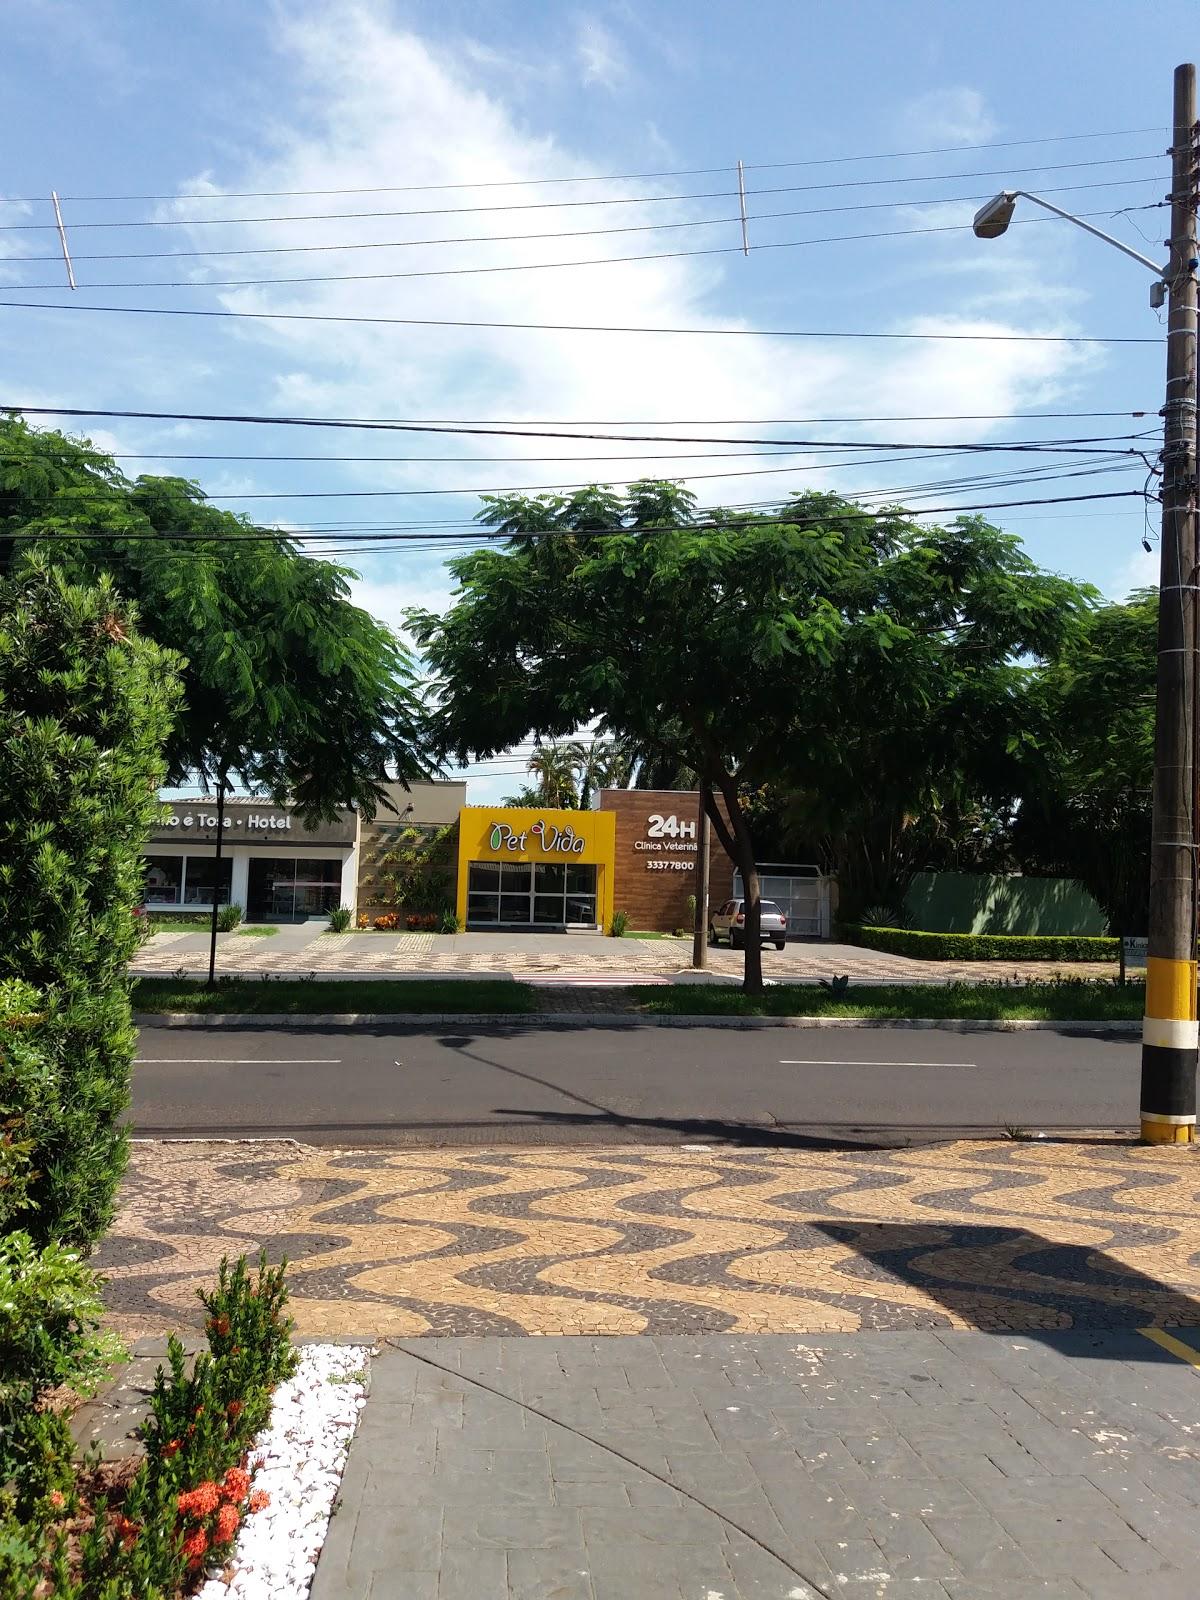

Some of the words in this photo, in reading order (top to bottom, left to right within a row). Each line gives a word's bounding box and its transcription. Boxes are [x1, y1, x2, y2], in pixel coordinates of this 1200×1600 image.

[248, 814, 291, 829] Hotel
[647, 814, 696, 839] 24H
[490, 821, 528, 852] Pet
[531, 819, 585, 853] Vida
[634, 841, 662, 850] Clínica
